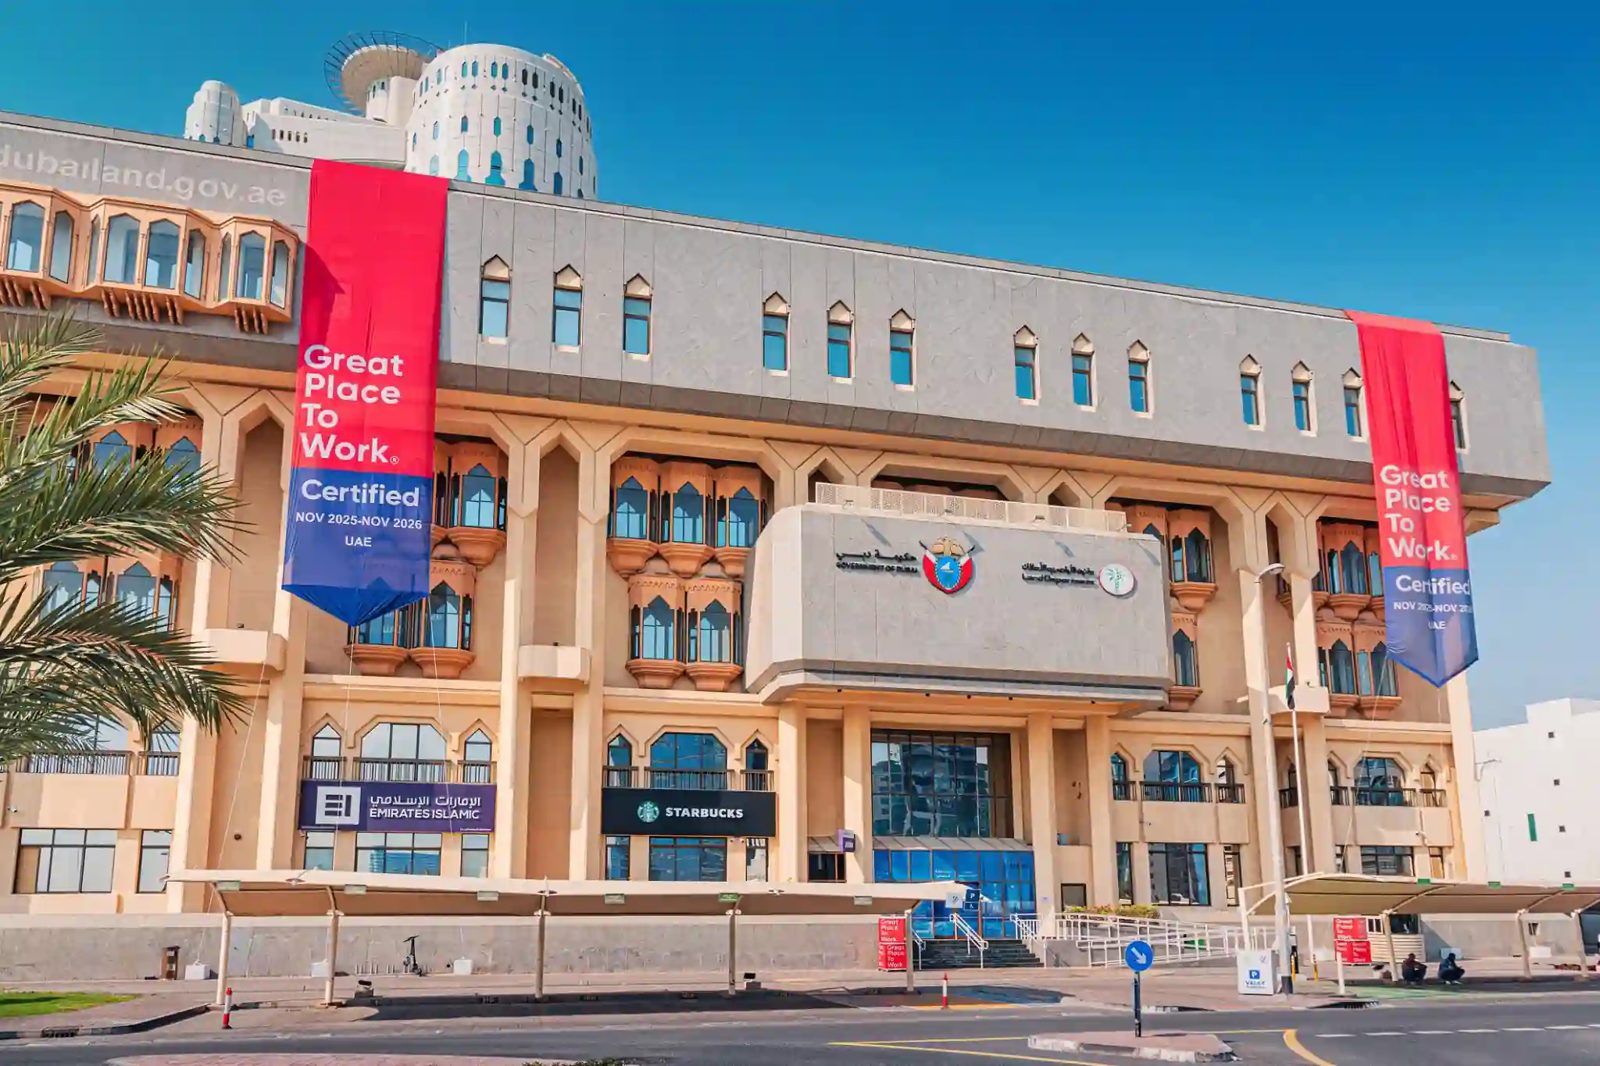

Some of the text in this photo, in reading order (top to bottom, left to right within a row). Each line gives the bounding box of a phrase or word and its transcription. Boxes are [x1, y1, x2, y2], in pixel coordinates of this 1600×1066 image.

[304, 344, 404, 376] Great
[304, 372, 400, 404] Place
[301, 403, 339, 428] To
[1380, 464, 1450, 489] Great
[301, 479, 420, 507] Certified
[1385, 488, 1451, 513] Place
[296, 512, 325, 523] NOV
[393, 518, 422, 530] 2026
[1384, 513, 1415, 533] To
[344, 536, 372, 548] UAE
[1396, 574, 1471, 595] Certified
[1393, 601, 1416, 610] NOV
[1428, 620, 1446, 630] UAE
[370, 796, 481, 808] الإمارات الإسلامي
[370, 808, 480, 820] EMIRATES ISLAMIC
[665, 807, 744, 818] STARBUCKS
